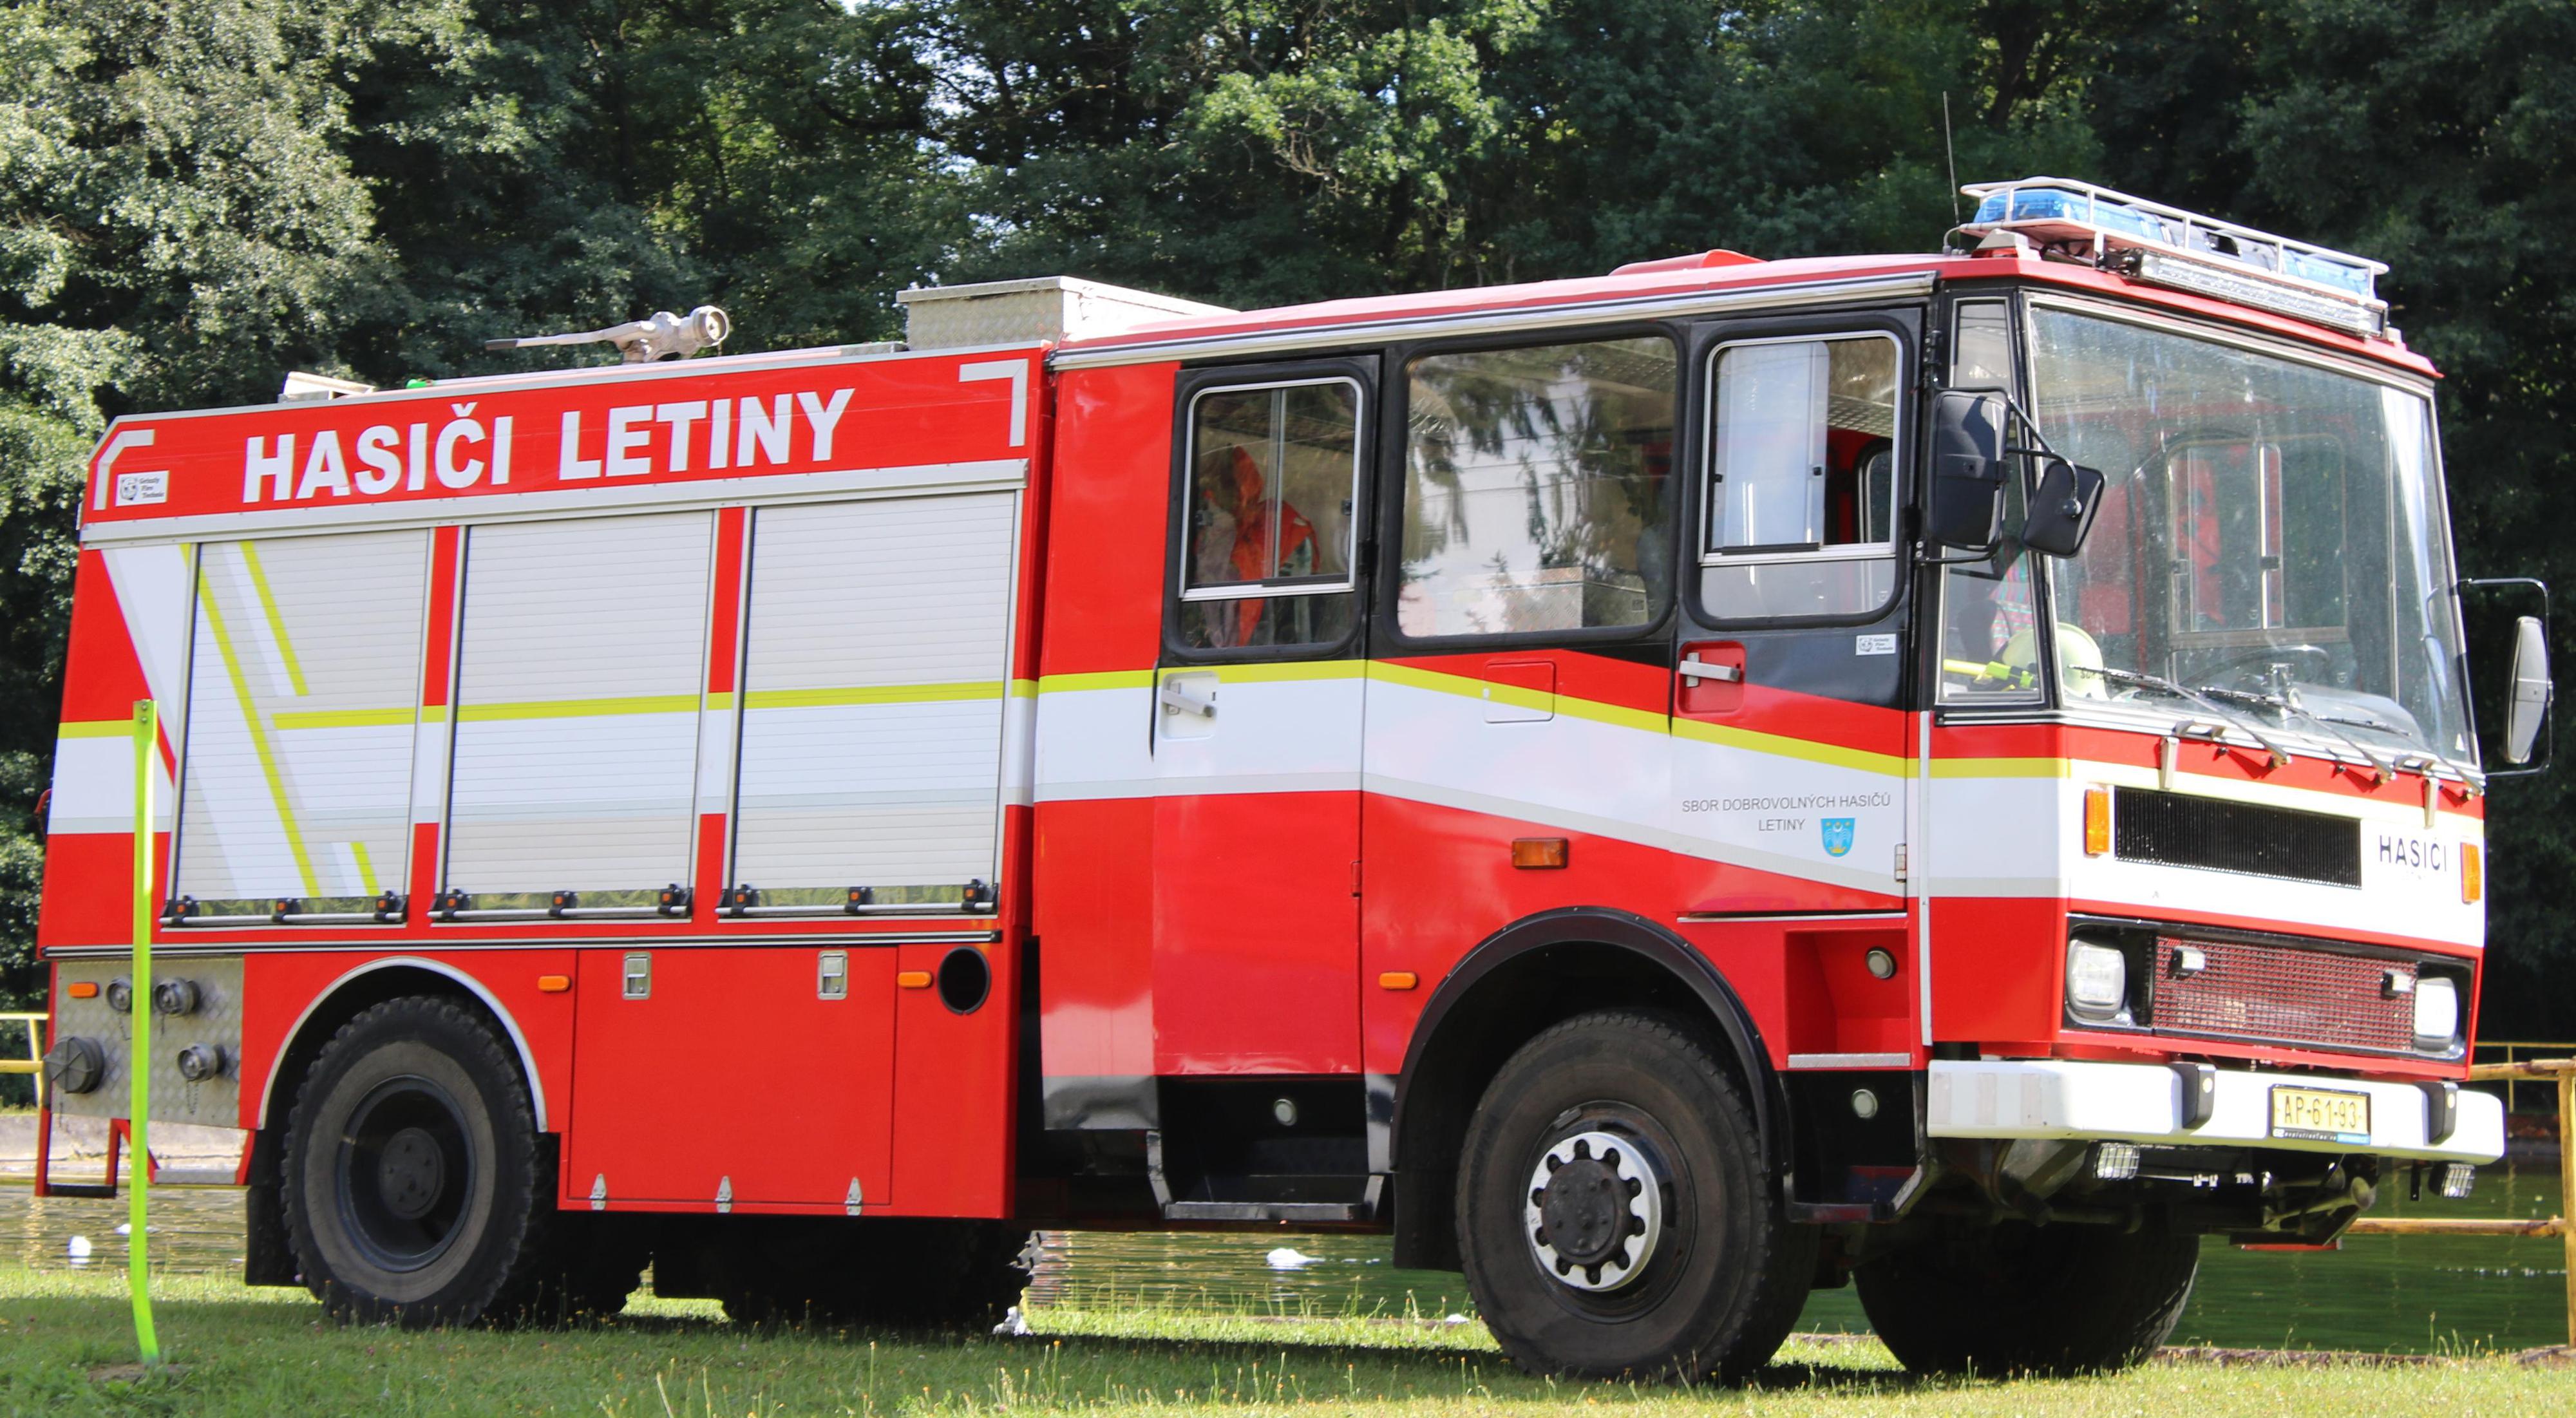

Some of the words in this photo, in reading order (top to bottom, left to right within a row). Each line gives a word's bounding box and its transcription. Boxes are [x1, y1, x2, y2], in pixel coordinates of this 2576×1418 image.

[243, 402, 513, 502] HASIČI
[560, 388, 855, 480] LETINY
[1682, 799, 1719, 813] SBOR
[1723, 794, 1835, 811] DOBROVOLNÝCH
[1839, 791, 1891, 808] HASIČŮ
[1758, 818, 1806, 831] LETINY
[2284, 1095, 2357, 1128] AP-61-93
